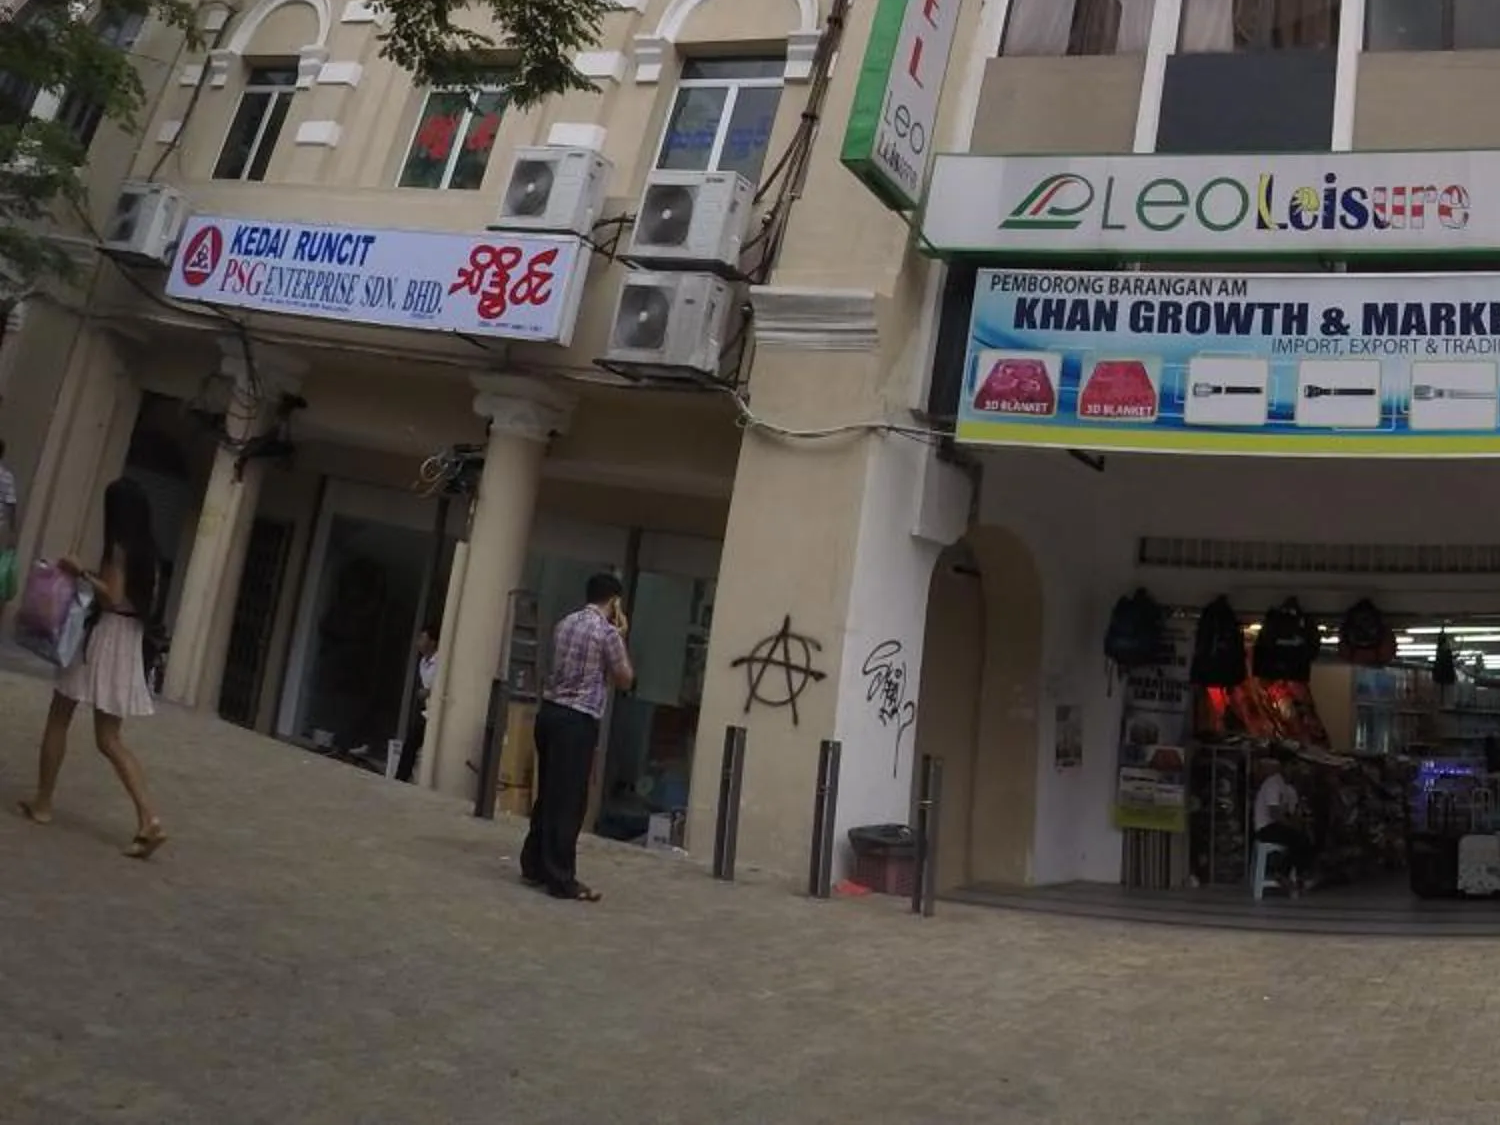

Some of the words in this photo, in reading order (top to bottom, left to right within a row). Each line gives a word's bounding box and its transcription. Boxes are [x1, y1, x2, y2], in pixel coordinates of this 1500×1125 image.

[229, 225, 289, 260] KEDAI
[294, 230, 376, 267] RUNCIT
[218, 258, 268, 297] PSG
[263, 267, 360, 306] ENTERPRISE
[361, 275, 397, 310] SDN.
[402, 279, 443, 314] BHD.
[990, 275, 1105, 296] PEMBORONG
[1108, 277, 1213, 297] BARANGAN
[1216, 279, 1248, 296] AM
[1013, 298, 1118, 332] KHAN
[1129, 300, 1309, 336] GROWTH
[1320, 306, 1351, 336] &
[1271, 338, 1345, 356] IMPORT,
[1350, 338, 1420, 356] EXPORT
[1425, 338, 1438, 354] &
[1000, 401, 1049, 414] BLANKET
[1087, 404, 1101, 416] 3D
[1103, 404, 1154, 417] BLANKET
